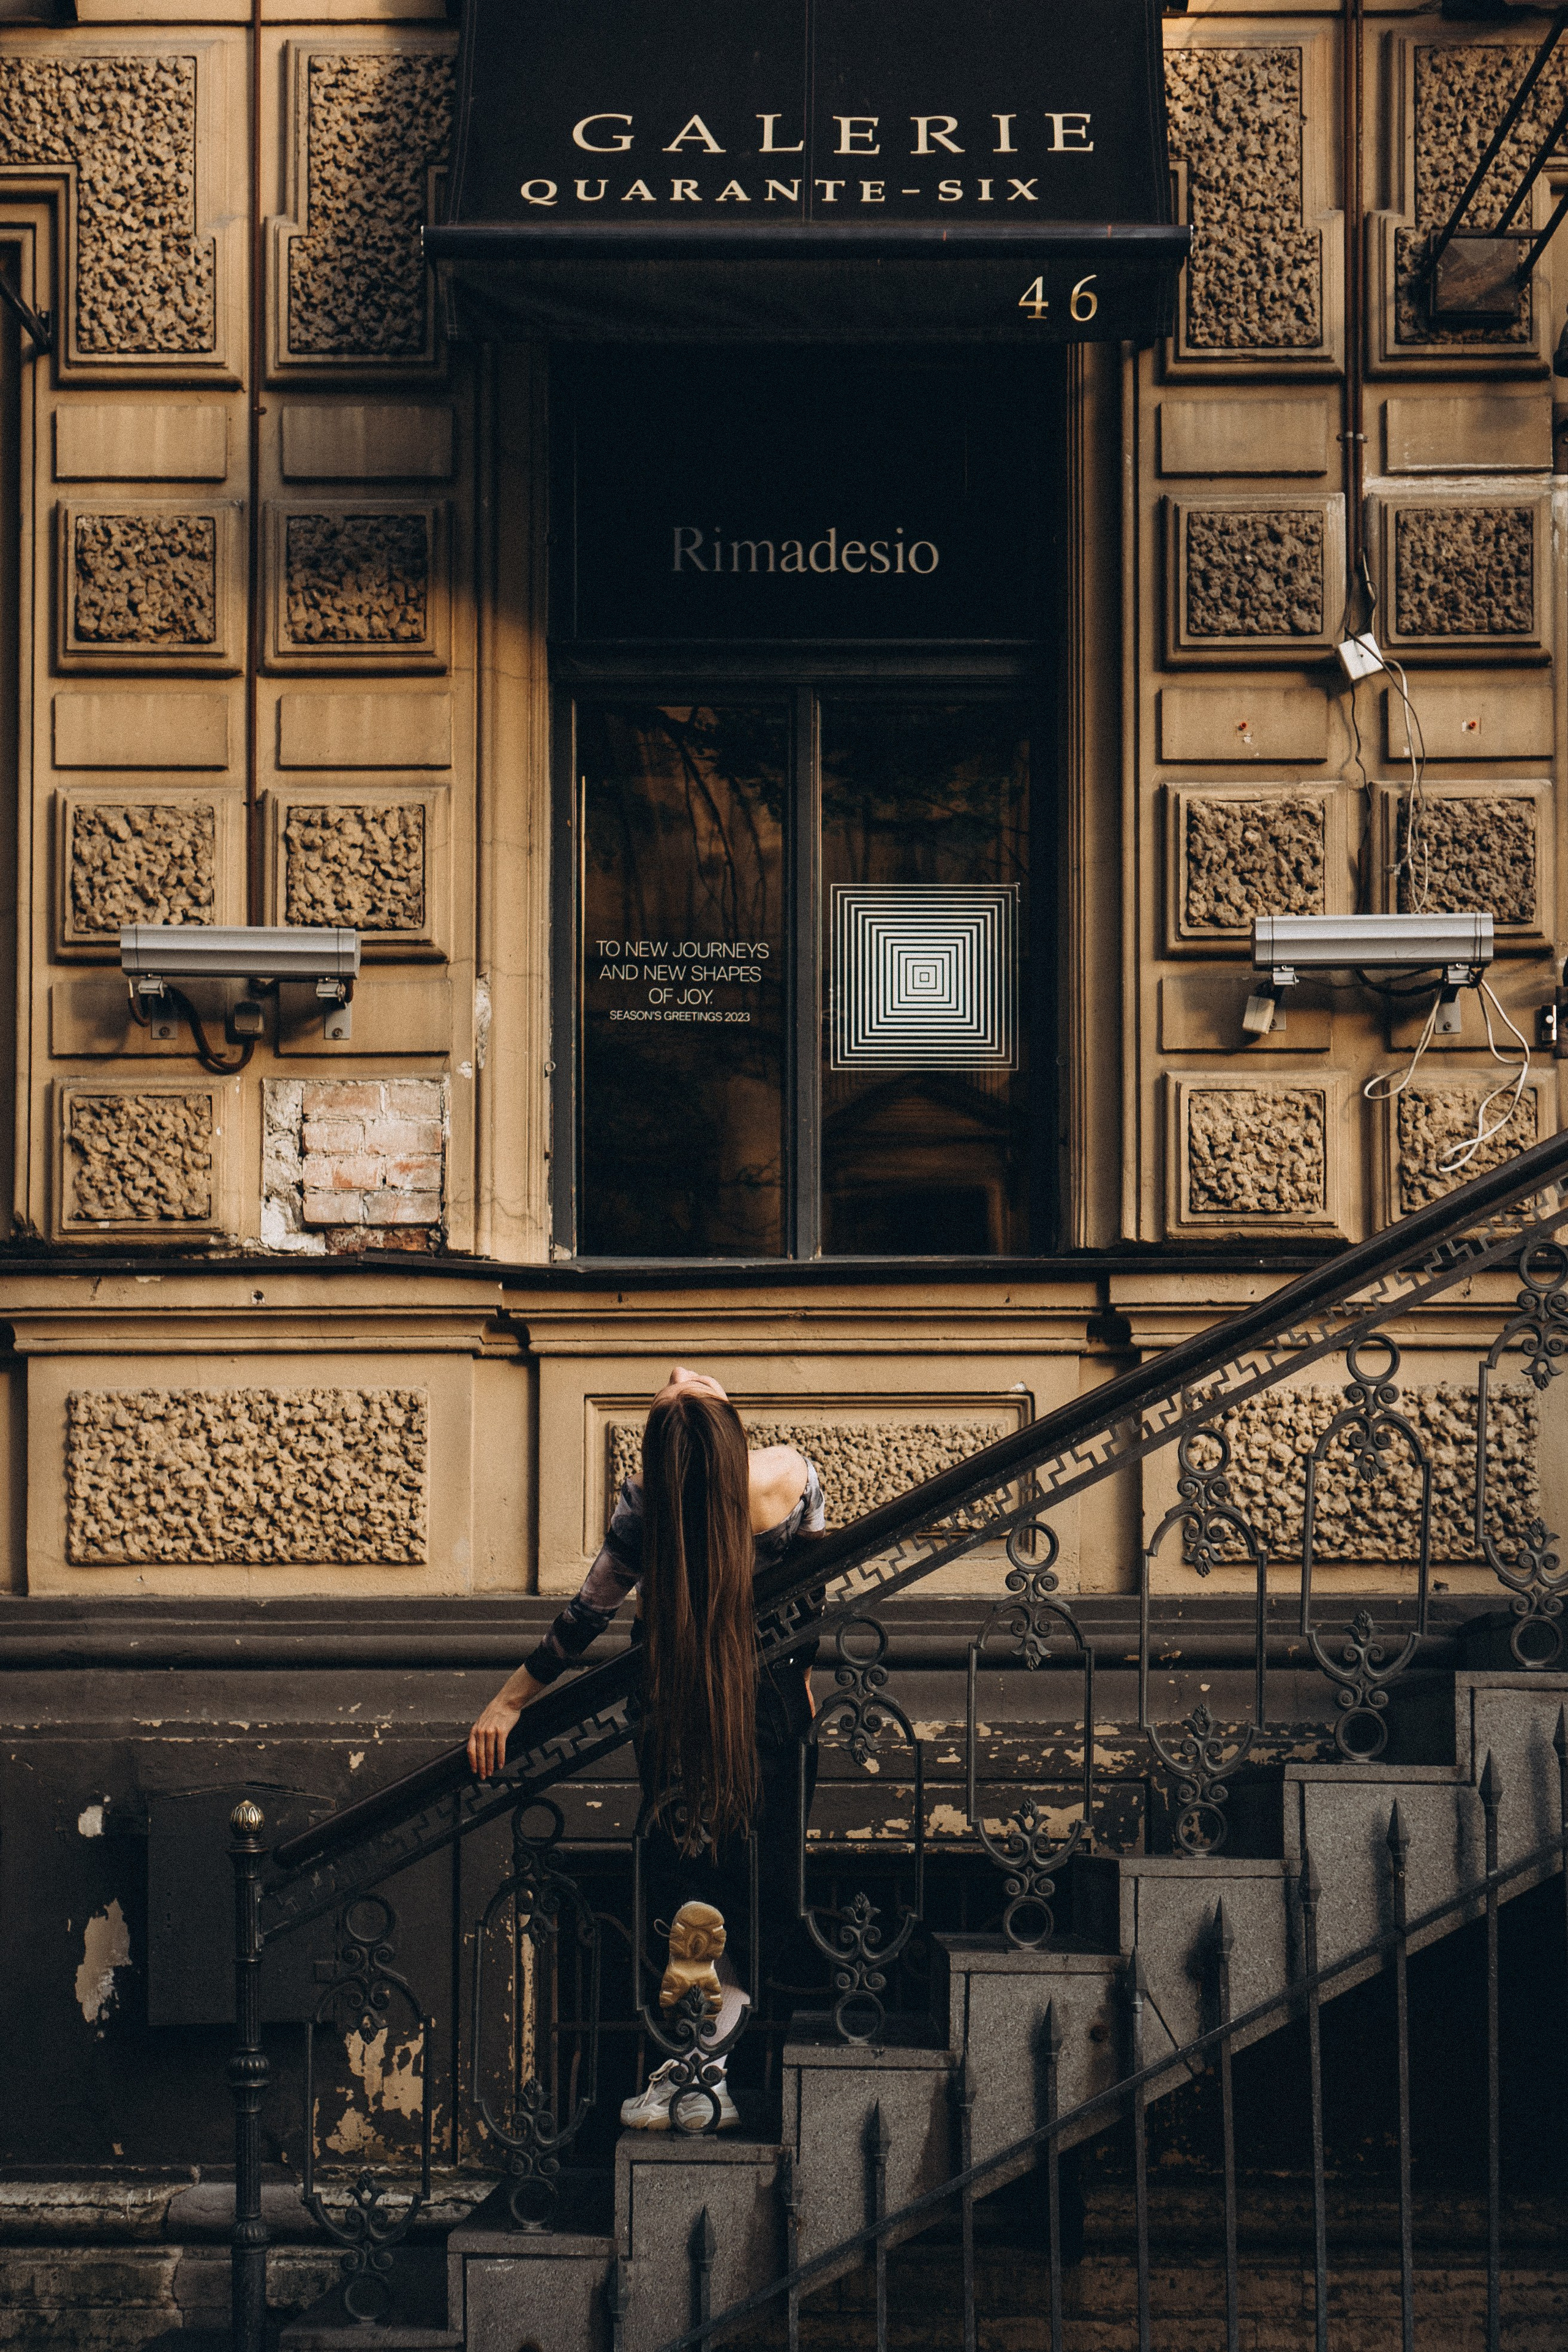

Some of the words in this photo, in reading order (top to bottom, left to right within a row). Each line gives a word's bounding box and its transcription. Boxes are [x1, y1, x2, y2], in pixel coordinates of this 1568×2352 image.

[572, 112, 1095, 155] GALERIE
[520, 178, 1040, 206] QUARANTE-SIX
[1018, 274, 1098, 322] 46
[671, 526, 940, 574] Rimadesio
[596, 940, 620, 957] TO
[625, 941, 668, 958] NEW
[673, 941, 770, 959] JOURNEYS
[599, 964, 639, 981] AND
[644, 965, 687, 981] NEW
[691, 965, 762, 983] SHAPES
[648, 987, 673, 1005] OF
[677, 988, 714, 1006] JOY.
[609, 1010, 662, 1021] SEASON'S
[663, 1011, 723, 1022] GREETINGS
[724, 1012, 751, 1022] 2023
